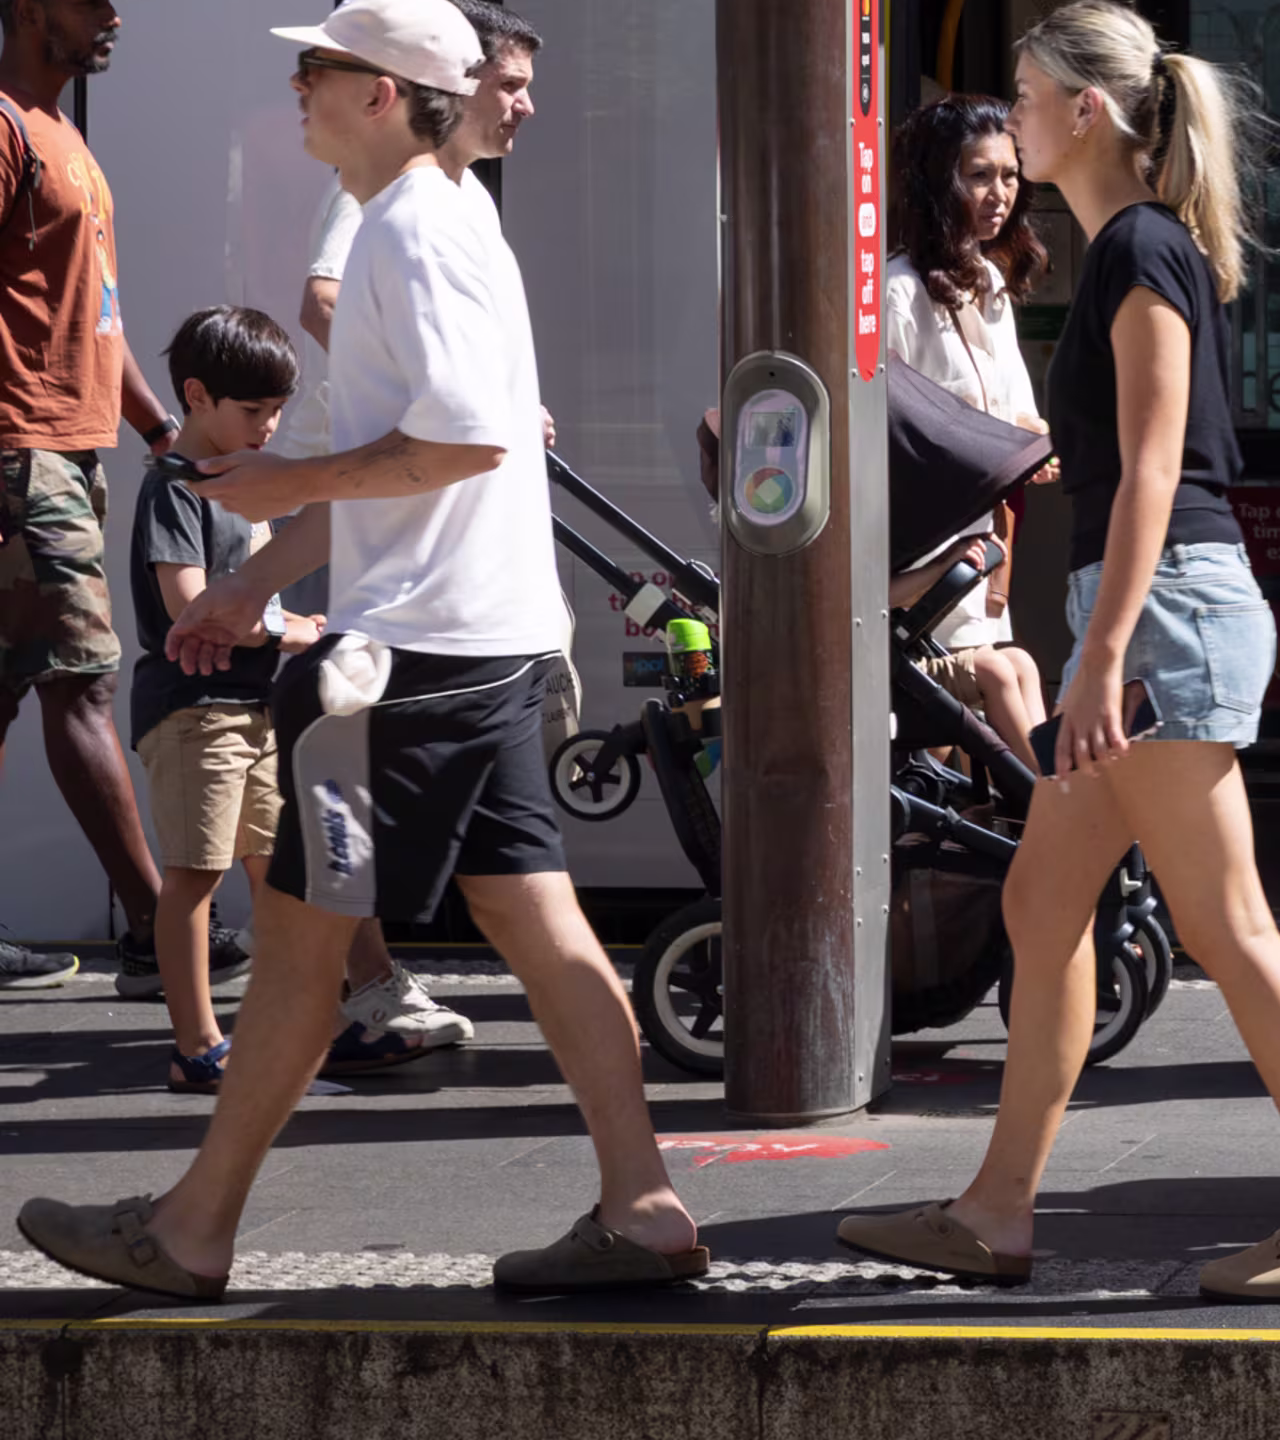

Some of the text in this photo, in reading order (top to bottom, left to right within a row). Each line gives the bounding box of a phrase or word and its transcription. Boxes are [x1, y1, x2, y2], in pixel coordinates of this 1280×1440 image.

[858, 142, 874, 173] Tap
[861, 174, 872, 194] on
[861, 249, 874, 277] tap
[861, 278, 874, 305] off
[858, 308, 877, 335] here
[1239, 504, 1271, 522] Tap
